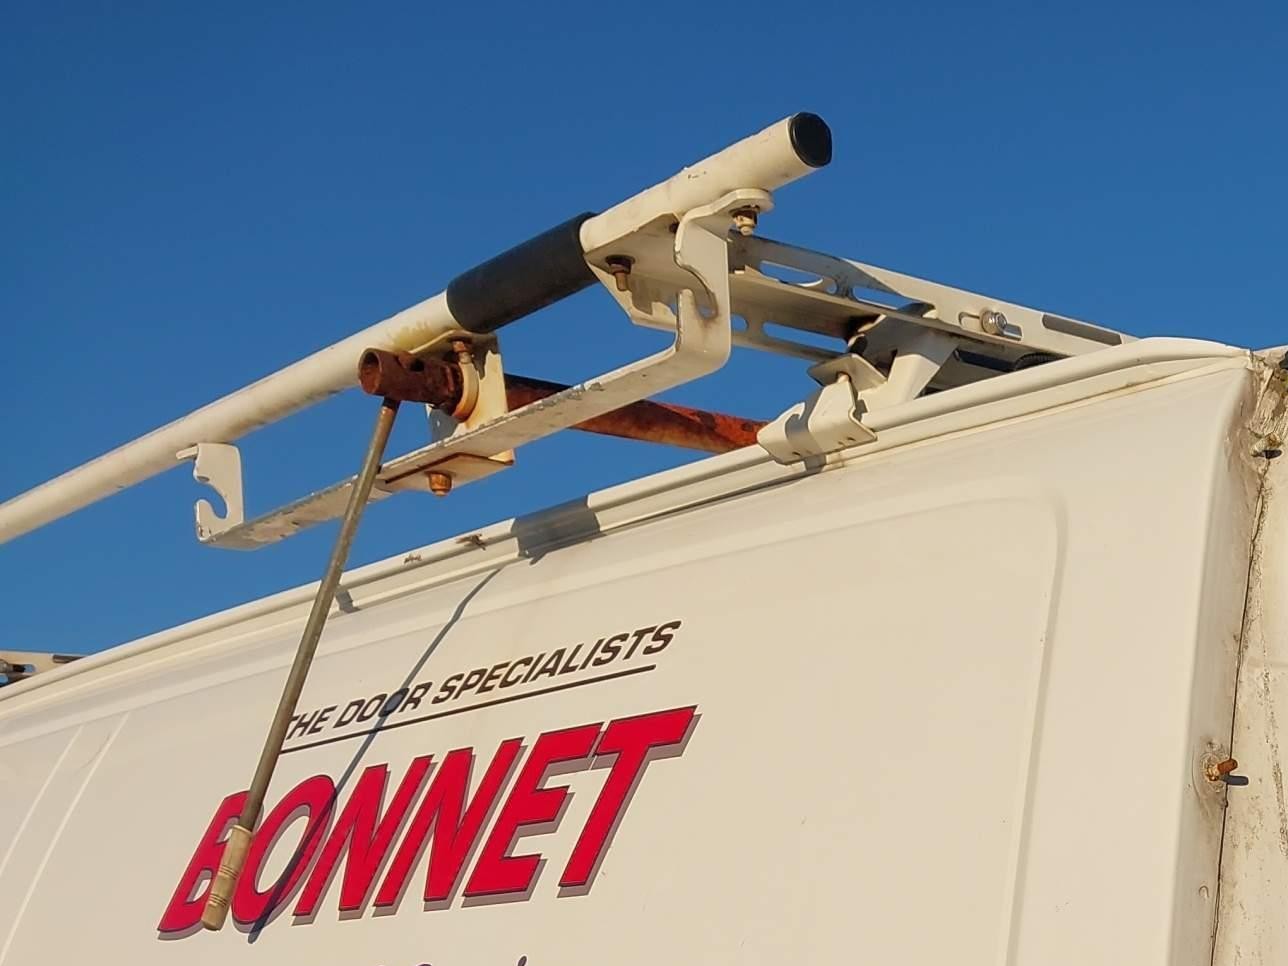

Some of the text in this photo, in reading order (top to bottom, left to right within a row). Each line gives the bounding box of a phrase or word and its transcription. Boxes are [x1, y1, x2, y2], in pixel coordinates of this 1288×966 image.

[333, 681, 434, 729] DOOR
[431, 620, 682, 705] SPECIALISTS
[157, 704, 702, 941] BONNET
